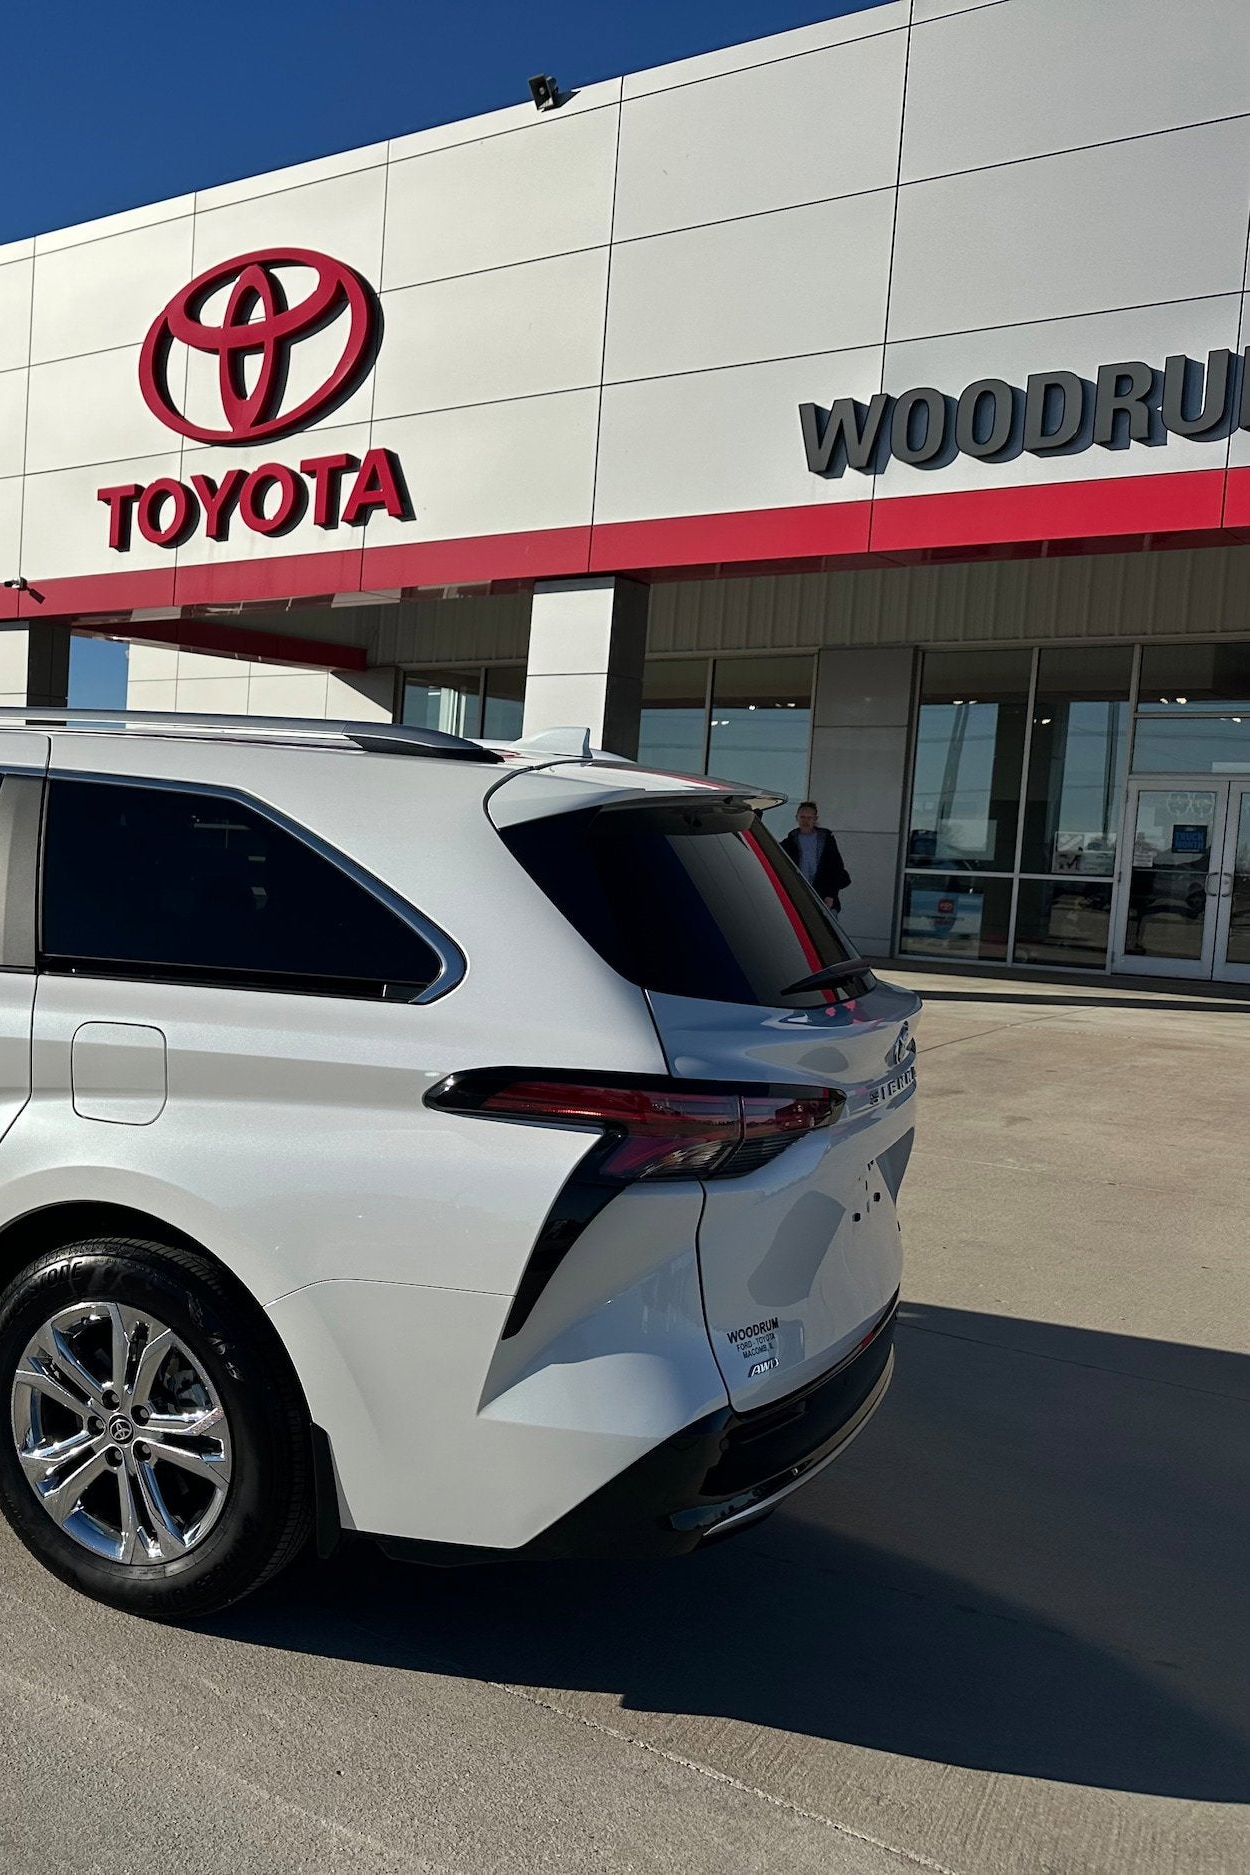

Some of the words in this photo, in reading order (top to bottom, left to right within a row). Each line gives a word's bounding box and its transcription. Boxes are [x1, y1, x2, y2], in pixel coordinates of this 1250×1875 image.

[798, 345, 1250, 479] WOODRU
[97, 447, 417, 553] TOYOTA
[726, 1317, 779, 1344] WOODRUM
[736, 1340, 753, 1352] FORD
[755, 1332, 776, 1345] TOYOTA
[750, 1357, 780, 1377] AWD
